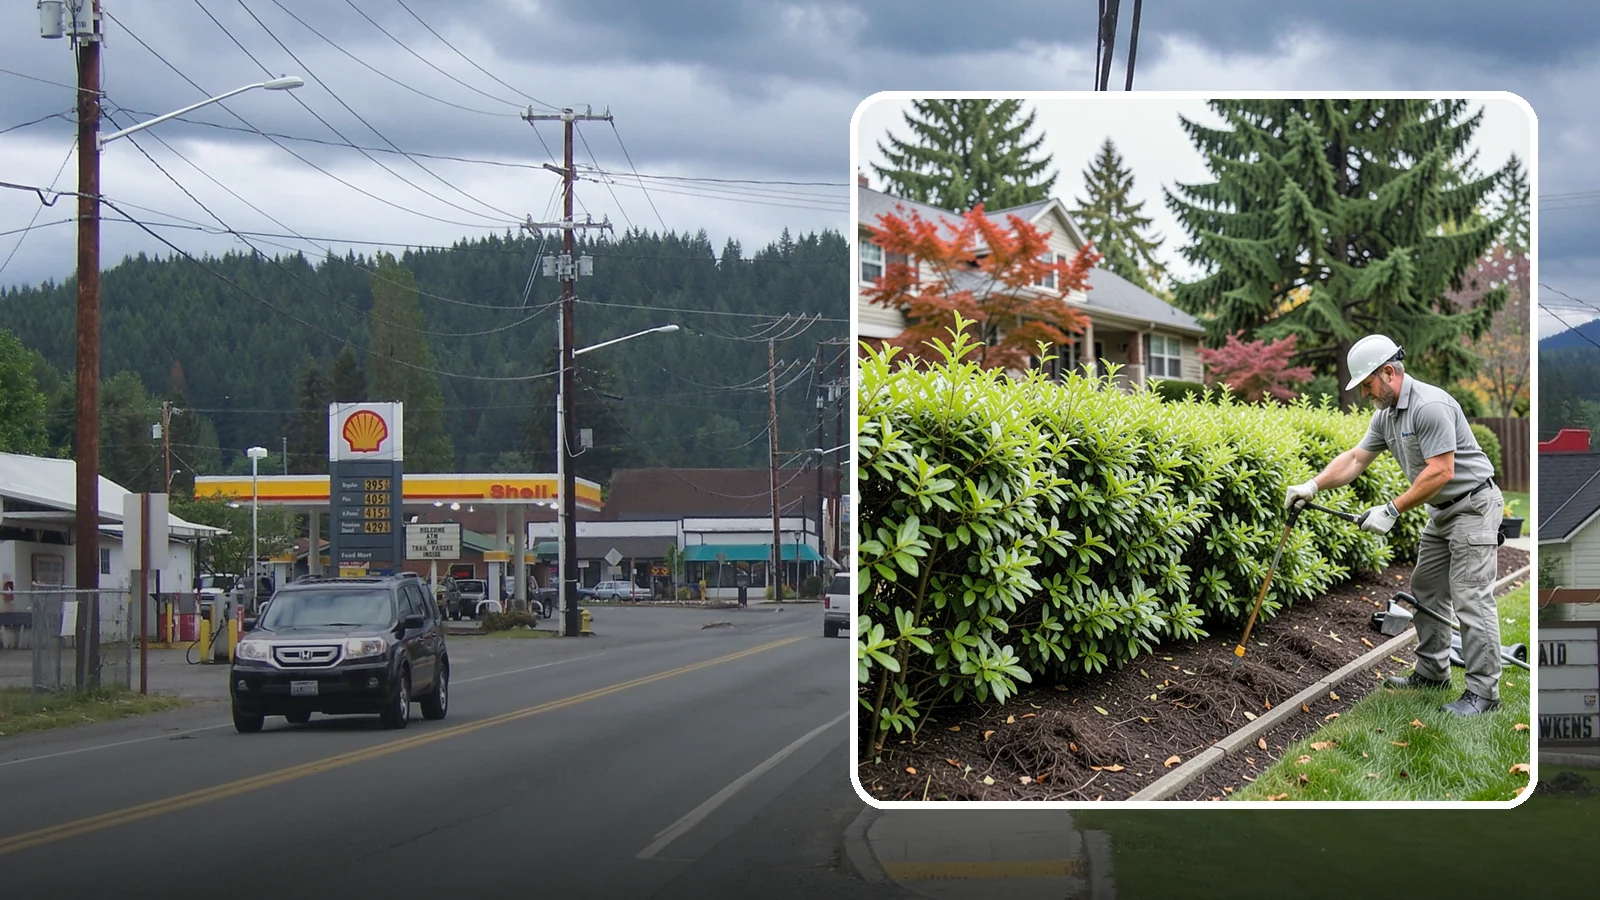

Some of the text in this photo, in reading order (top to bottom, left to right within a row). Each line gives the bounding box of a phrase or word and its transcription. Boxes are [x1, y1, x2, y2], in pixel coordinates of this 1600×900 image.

[366, 480, 383, 490] 395
[490, 484, 547, 499] Shell
[366, 494, 383, 504] 405
[366, 508, 383, 518] 415
[366, 522, 383, 532] 429
